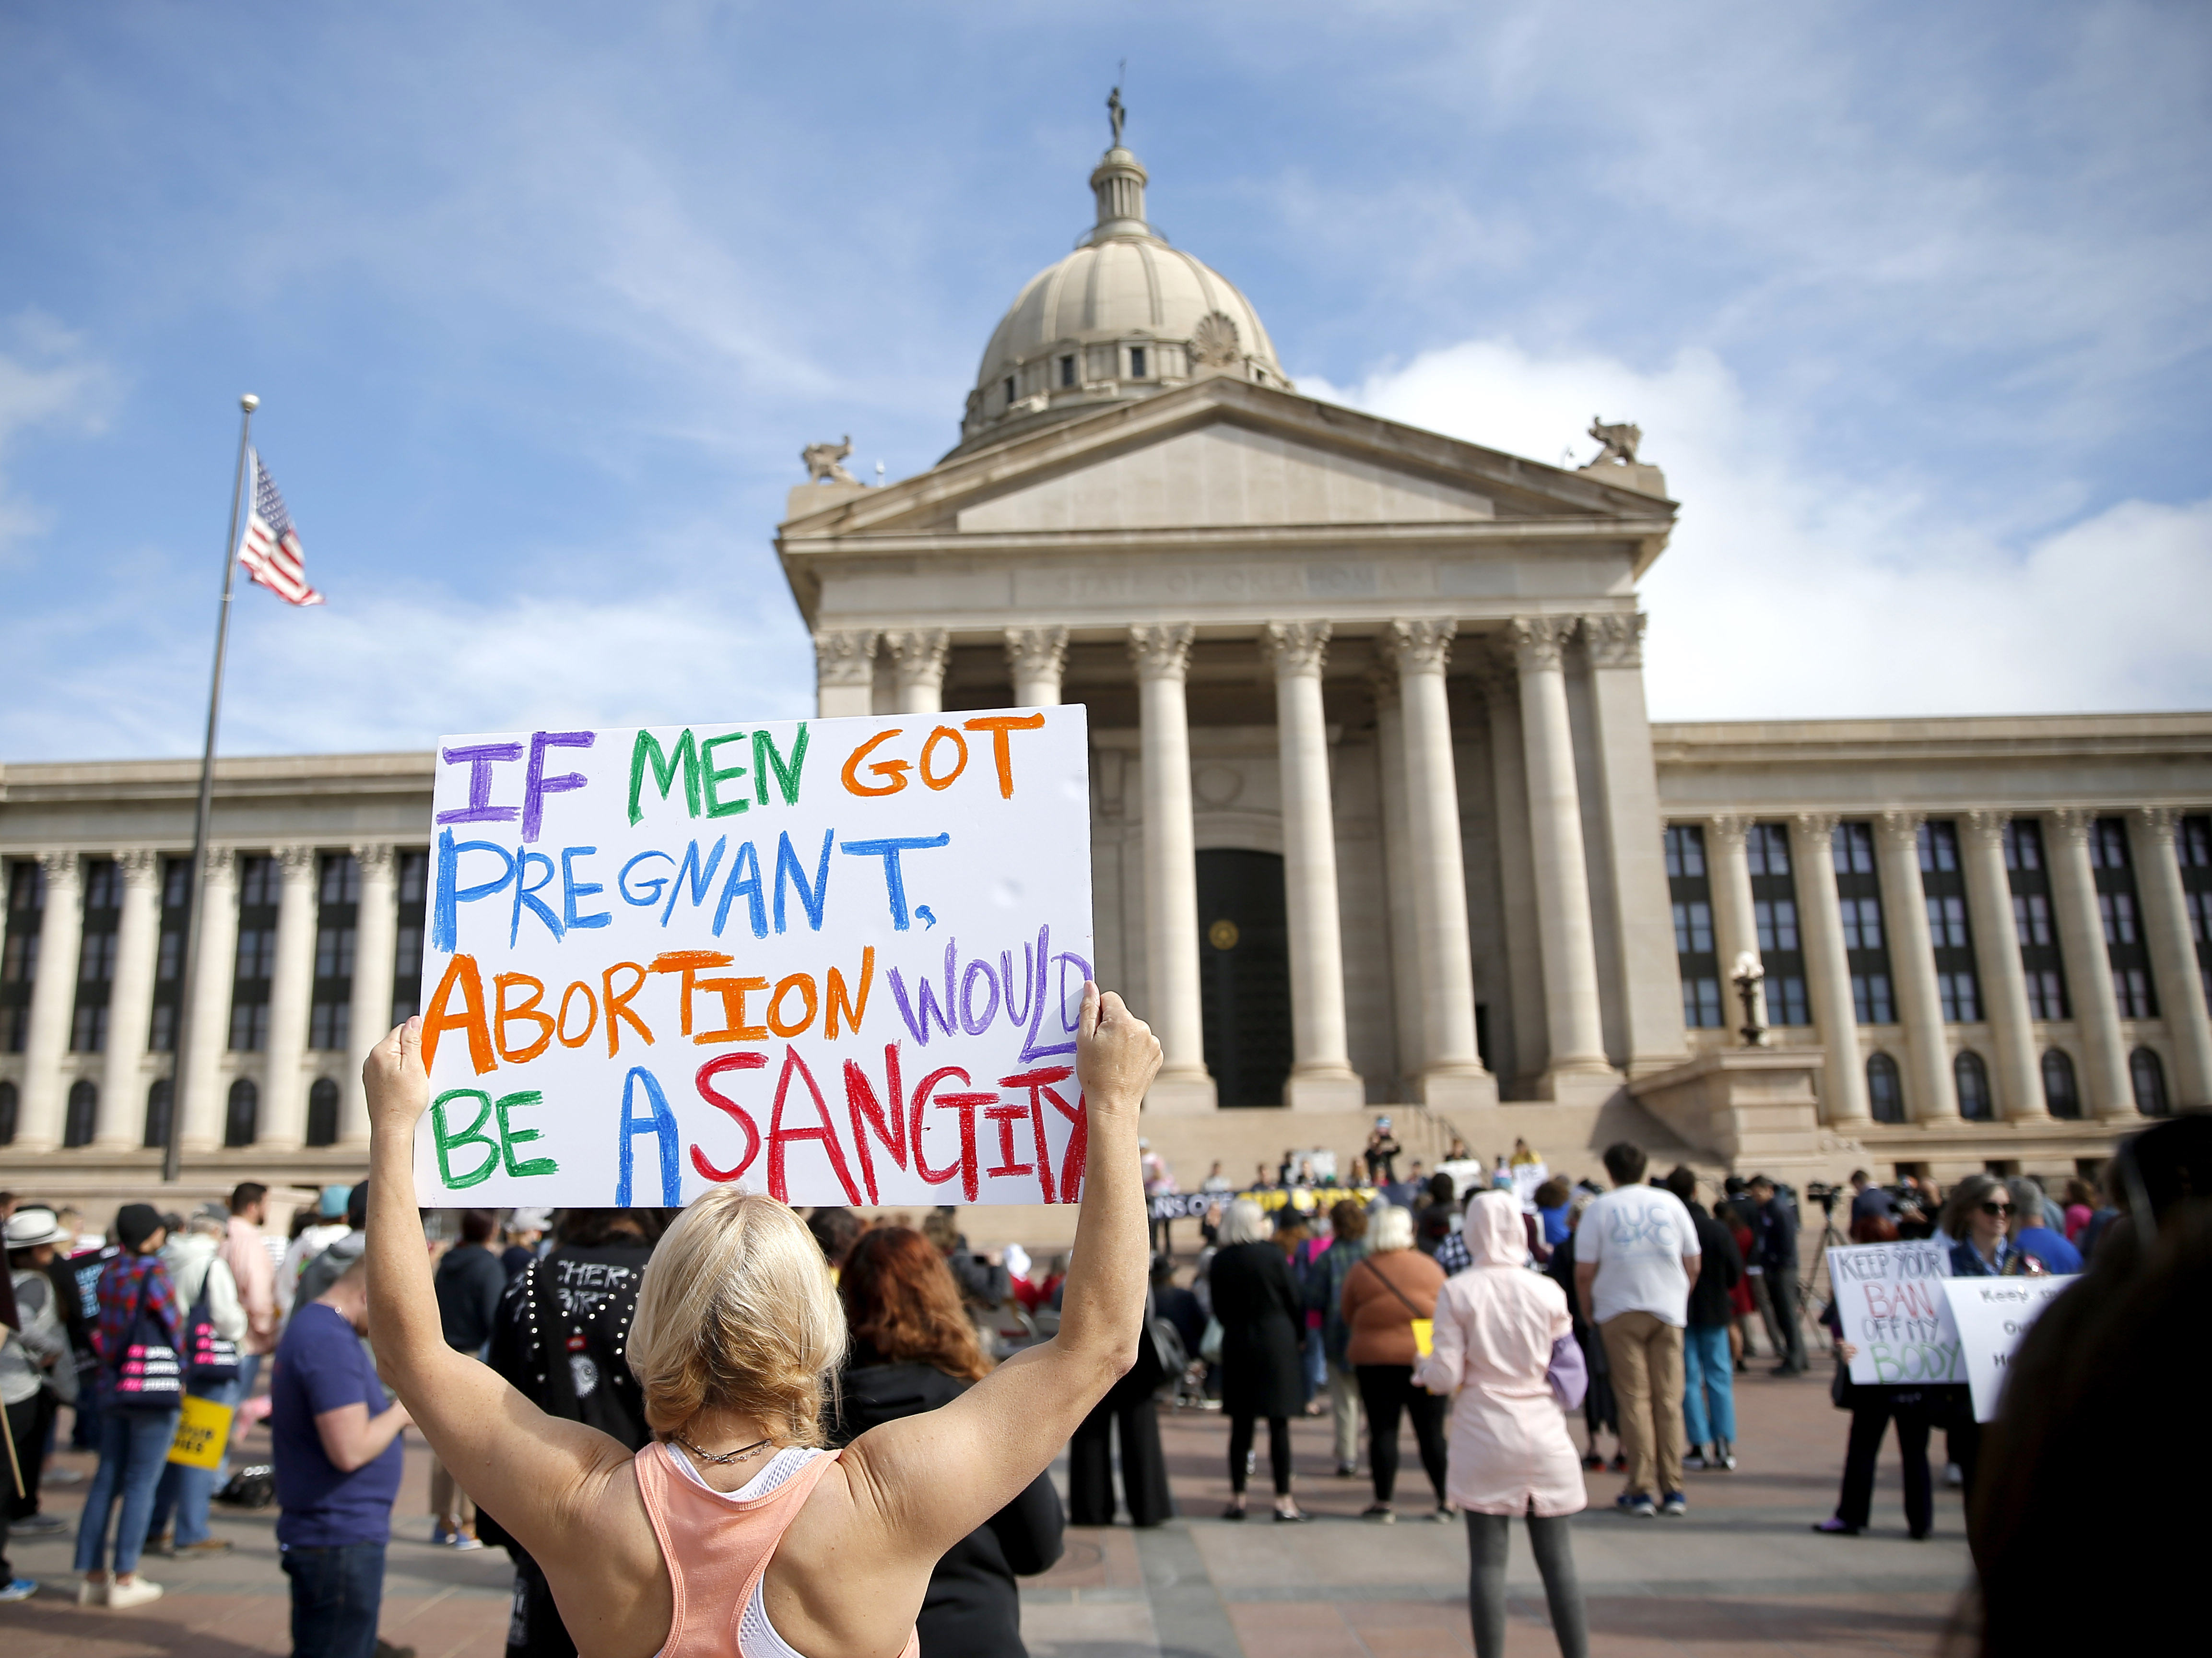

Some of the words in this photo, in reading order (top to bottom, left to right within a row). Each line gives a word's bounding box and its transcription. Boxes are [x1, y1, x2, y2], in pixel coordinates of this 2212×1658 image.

[1056, 572, 1145, 598] STATE
[1166, 571, 1204, 595] OF
[1222, 565, 1400, 594] OKLAHOMA
[436, 730, 596, 843] IF
[628, 722, 810, 826] MEN
[841, 712, 1045, 800] GOT
[432, 828, 950, 952] PREGNANT,
[421, 946, 874, 1078] ABORTION
[885, 923, 1093, 1063] WOULD
[430, 1088, 559, 1189] BE
[615, 1066, 682, 1207] A
[1837, 1249, 1890, 1283] KEEP
[1892, 1246, 1945, 1281] YOUR
[1862, 1280, 1935, 1319] BAN
[1861, 1316, 1902, 1342] OFF
[1906, 1316, 1939, 1342] MY
[1869, 1338, 1961, 1385] BODY
